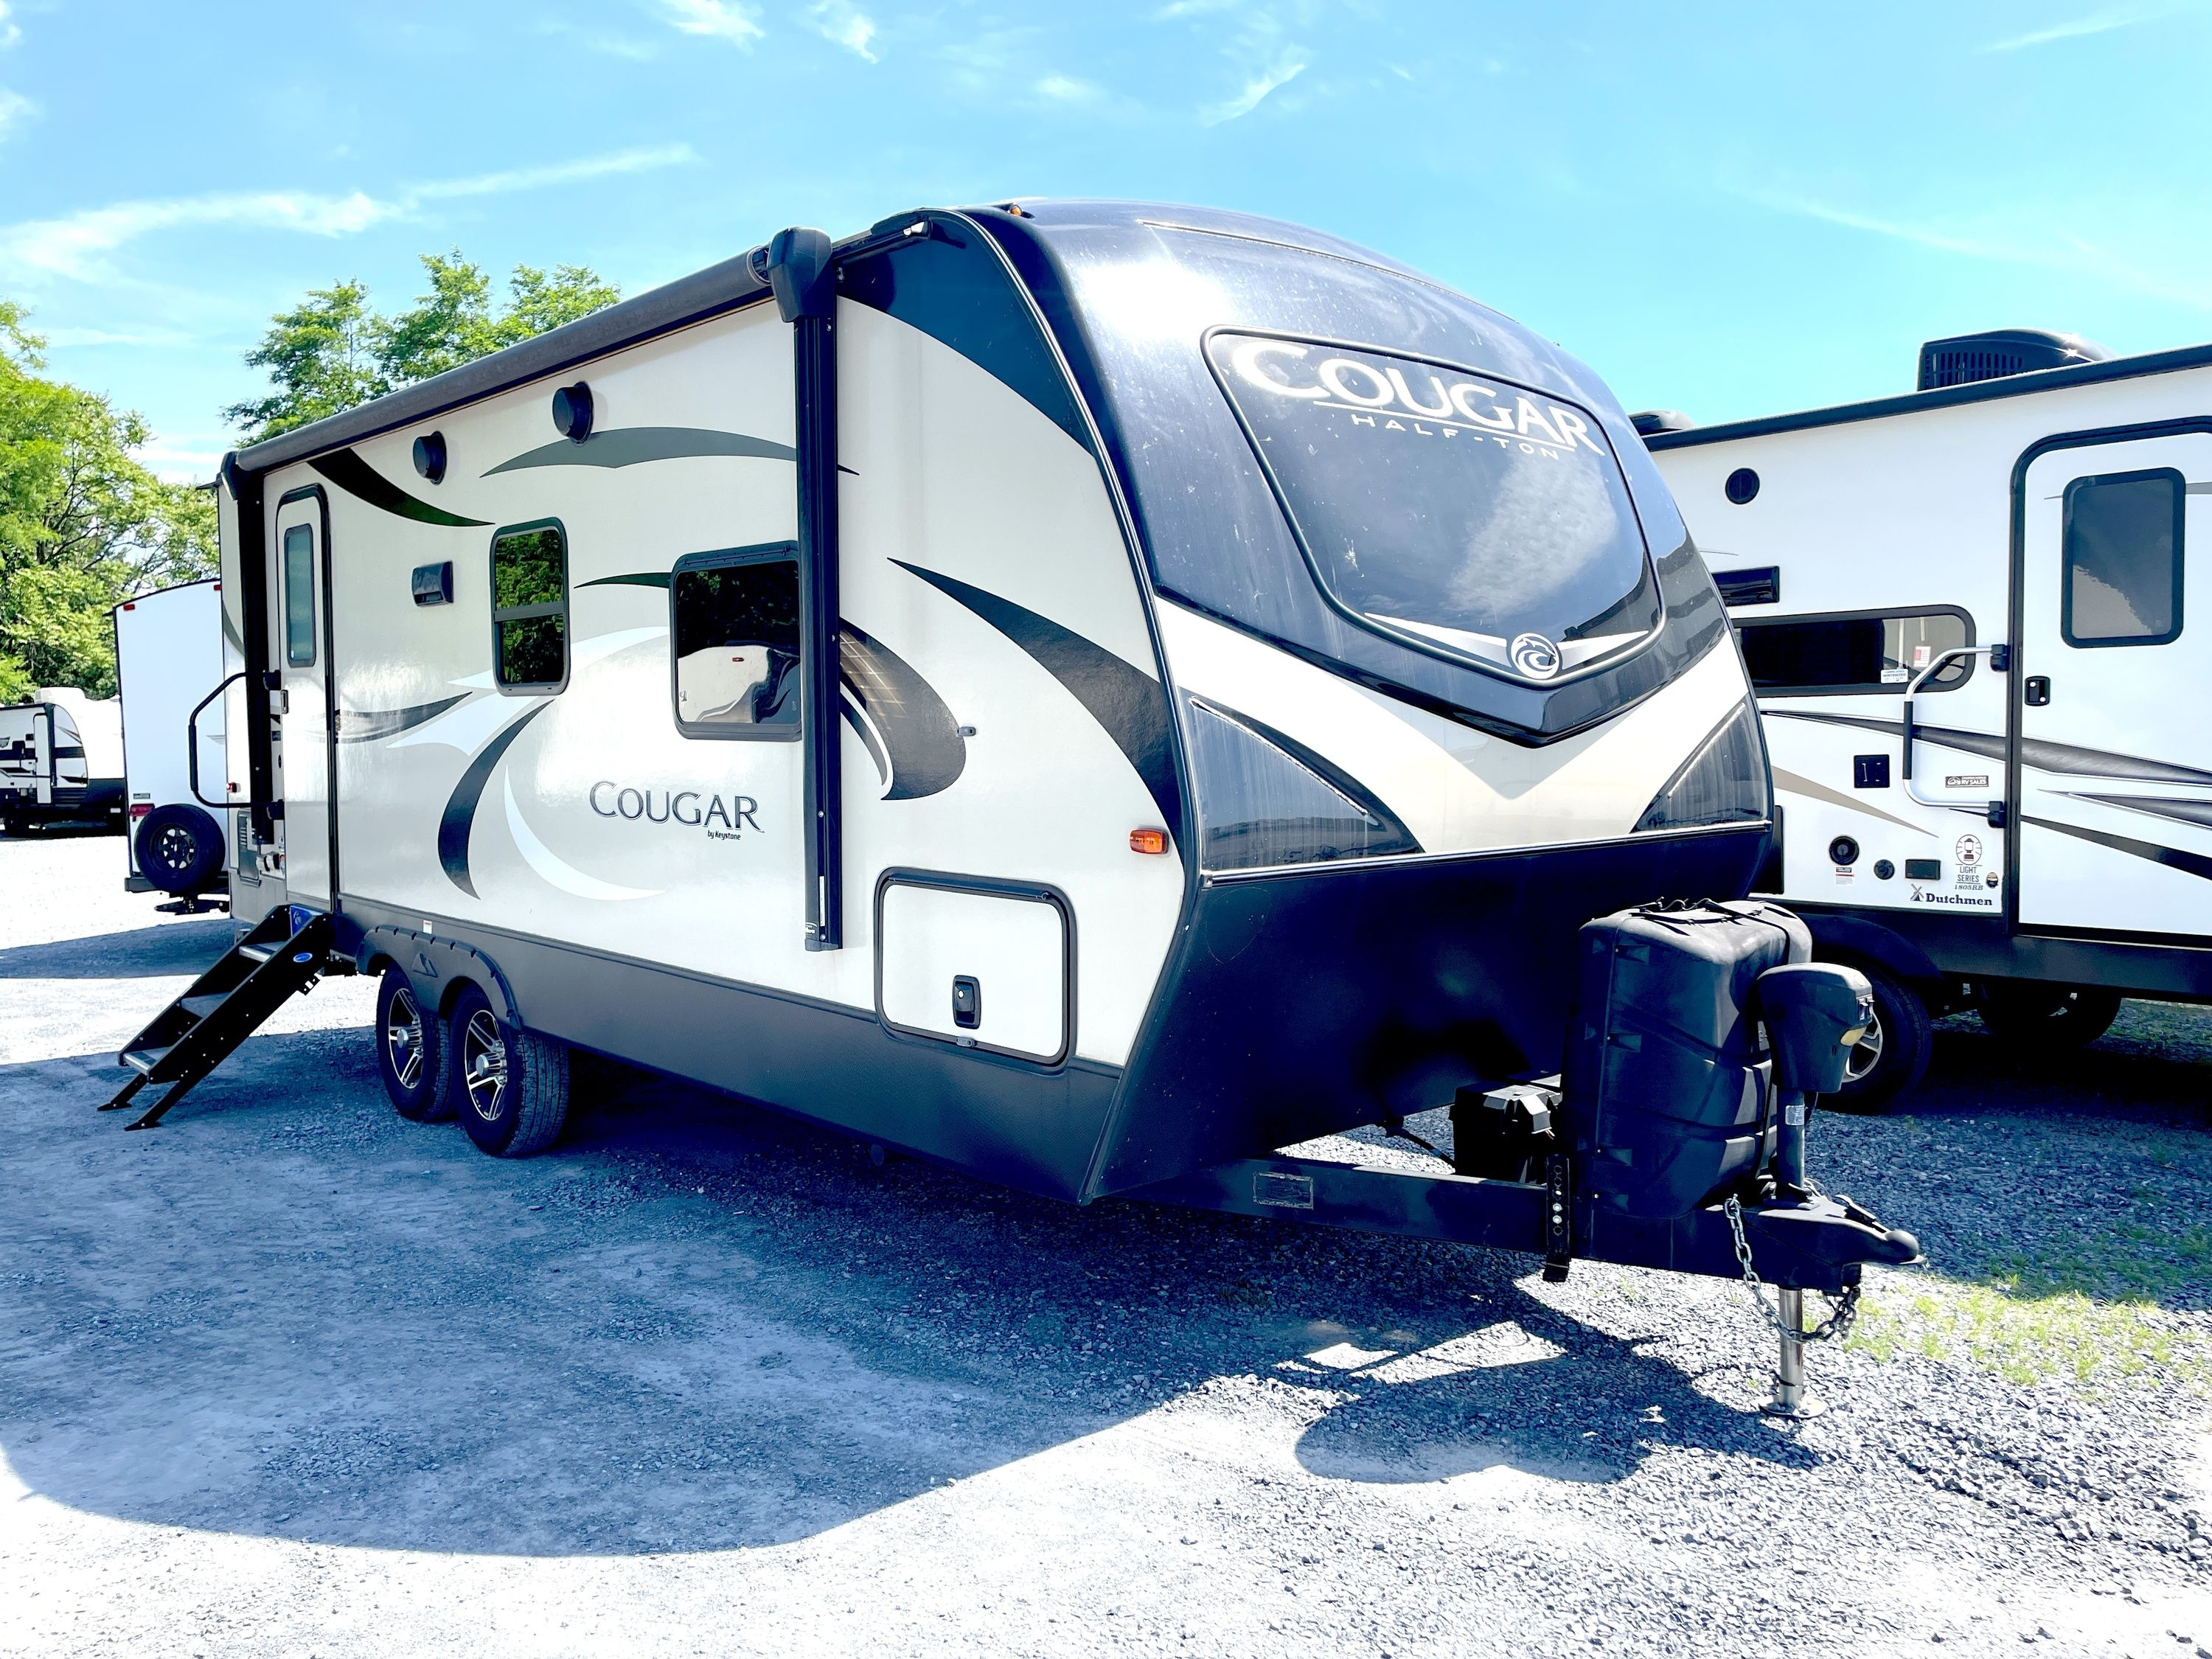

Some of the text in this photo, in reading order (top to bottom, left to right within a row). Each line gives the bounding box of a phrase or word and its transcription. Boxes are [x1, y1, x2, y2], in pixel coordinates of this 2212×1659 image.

[1231, 340, 1606, 456] COUGAR
[1352, 413, 1559, 460] HALF-TON
[590, 781, 765, 833] COUGAR
[707, 830, 741, 841] by Keystone
[1957, 874, 1980, 883] SERIES
[1926, 892, 1992, 905] Dutchmen
